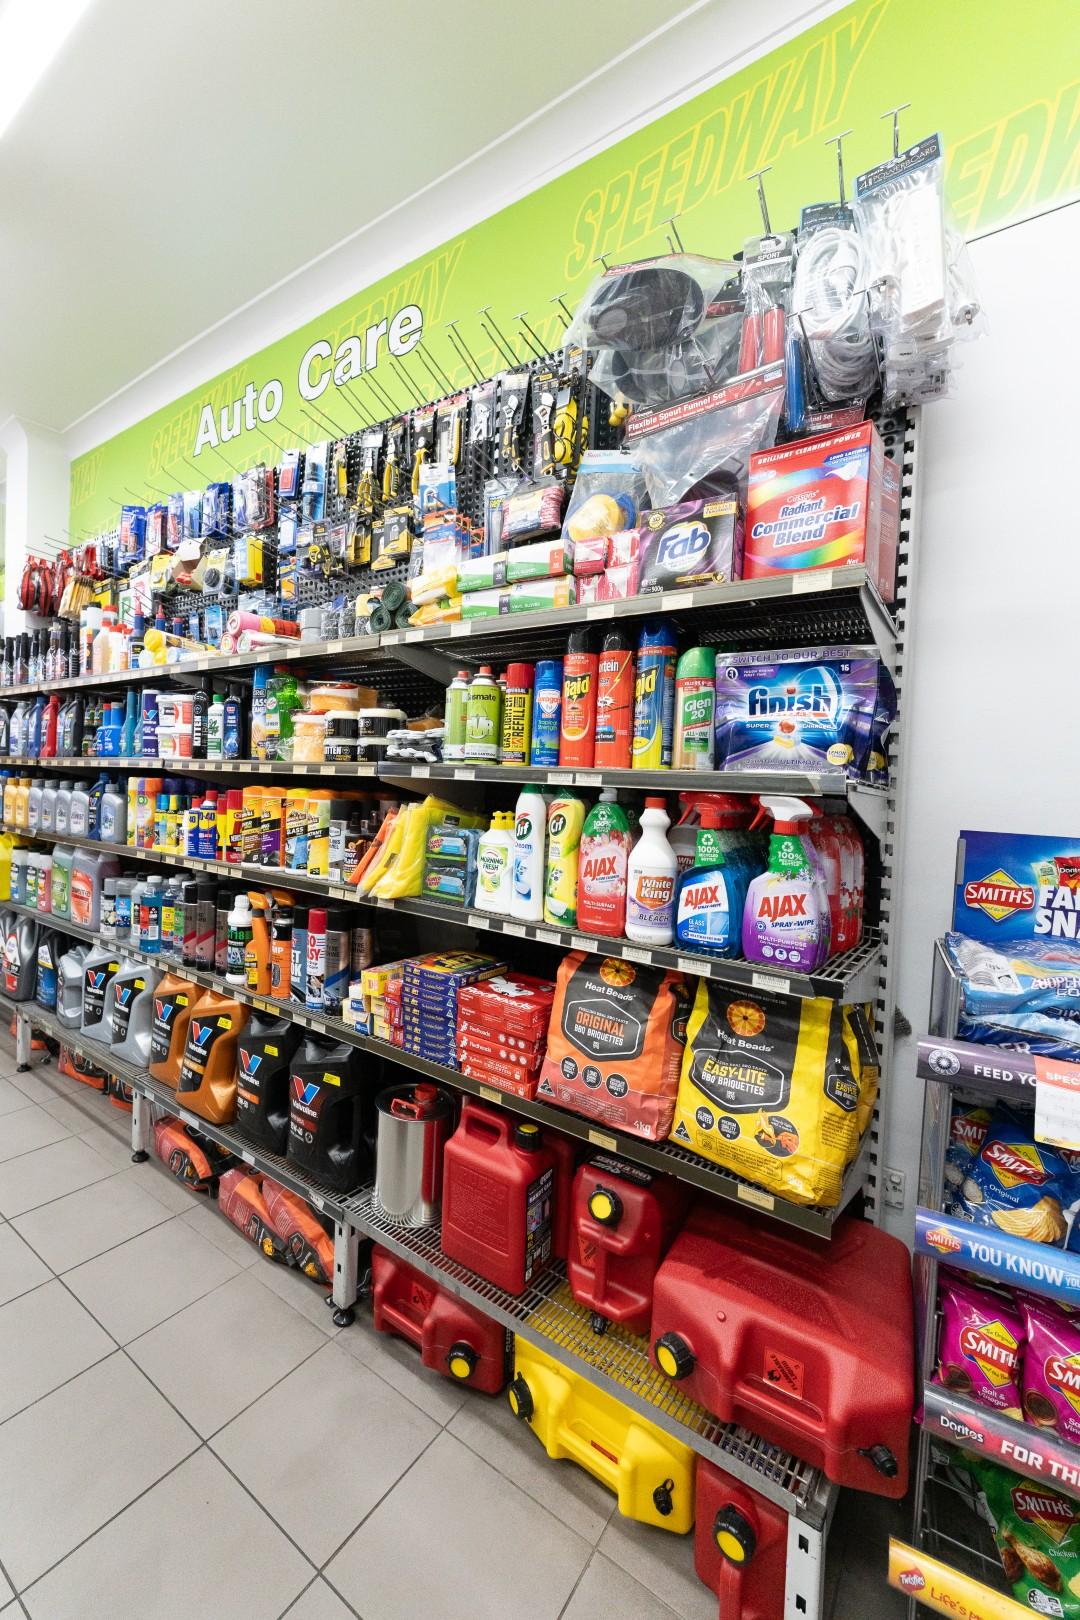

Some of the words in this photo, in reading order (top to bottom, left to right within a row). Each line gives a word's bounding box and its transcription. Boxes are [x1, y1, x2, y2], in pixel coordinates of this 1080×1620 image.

[565, 0, 890, 280] SPEEDWAY
[757, 251, 781, 262] SPORT
[193, 379, 283, 458] Auto
[297, 303, 424, 401] Care
[628, 416, 657, 432] Flexible
[658, 407, 683, 422] Spout
[684, 397, 712, 413] Funnel
[713, 390, 727, 402] Set
[757, 451, 794, 465] BRILLIANT
[795, 441, 832, 456] CLEANING
[833, 431, 862, 445] POWER
[780, 498, 823, 519] Radiant
[752, 504, 859, 538] Commercial
[656, 527, 710, 564] Fab
[774, 524, 825, 547] Blend
[733, 655, 771, 665] SWITCH
[776, 653, 789, 661] TO
[793, 650, 818, 660] OUR
[822, 648, 851, 658] BEST
[564, 675, 591, 697] Raid
[636, 669, 657, 696] aid
[684, 698, 711, 712] Glen
[748, 685, 831, 716] finish
[505, 696, 513, 732] LIGHTER
[512, 708, 525, 737] REFILL
[690, 709, 706, 720] 20
[503, 732, 511, 748] GAS
[516, 820, 529, 837] Jif
[550, 814, 564, 834] Cif
[698, 845, 719, 854] 100%
[777, 851, 803, 861] 100%
[480, 855, 504, 866] MORNING
[482, 862, 499, 871] FRESH
[583, 856, 617, 881] AJAX
[640, 886, 670, 902] King
[641, 878, 672, 890] White
[966, 883, 1034, 906] SMITH'S
[683, 885, 720, 910] AJAX
[758, 893, 808, 923] AJAX
[638, 913, 669, 922] BLEACH
[688, 918, 705, 927] GLASS
[770, 921, 793, 929] SPRAY
[797, 919, 815, 928] WIPE
[758, 935, 808, 949] MULTI-PURPOSE
[585, 980, 605, 994] Heat
[605, 987, 634, 1001] Beads
[575, 1010, 625, 1038] ORIGINAL
[574, 1023, 586, 1035] BBQ
[587, 1028, 624, 1047] BRIQUETTES
[717, 1029, 737, 1046] Heat
[738, 1038, 772, 1052] Beads
[239, 1070, 260, 1087] Valvoline
[703, 1058, 767, 1087] EASY-LITE
[973, 1064, 1014, 1082] FEED
[701, 1071, 715, 1084] BBQ
[717, 1077, 765, 1097] BRIQUETTES
[292, 1098, 318, 1118] Valvoline
[633, 1119, 652, 1137] 4kg
[988, 1183, 1020, 1204] Original
[967, 1240, 1002, 1267] YOU
[1006, 1252, 1066, 1287] KNOW
[977, 1390, 1009, 1408] Vinegar
[982, 1386, 998, 1398] Salt
[940, 1415, 985, 1443] Doritos
[1000, 1439, 1044, 1471] FOR
[1015, 1491, 1074, 1518] SMITH'S
[1048, 1548, 1078, 1559] Chicken
[899, 1573, 925, 1587] Twisties
[930, 1586, 967, 1616] Life's
